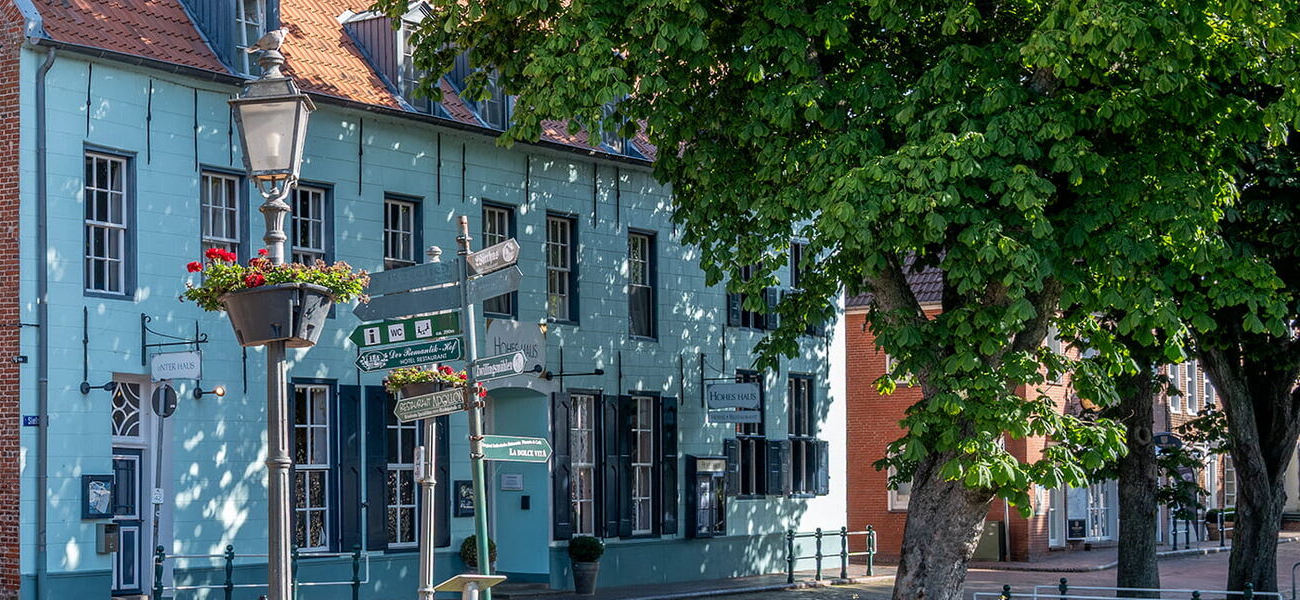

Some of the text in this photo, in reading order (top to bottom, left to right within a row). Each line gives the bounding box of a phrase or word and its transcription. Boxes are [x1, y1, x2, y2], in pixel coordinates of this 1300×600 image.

[389, 328, 403, 337] WC
[389, 350, 402, 358] Der
[400, 353, 447, 365] HOTEL RESTAURANT
[177, 361, 195, 370] HAUS
[400, 397, 431, 412] RESTAURANT
[432, 388, 464, 408] APOLLON
[709, 391, 757, 401] HOHES HAUS
[509, 448, 517, 456] LA
[517, 449, 533, 457] DOLCE
